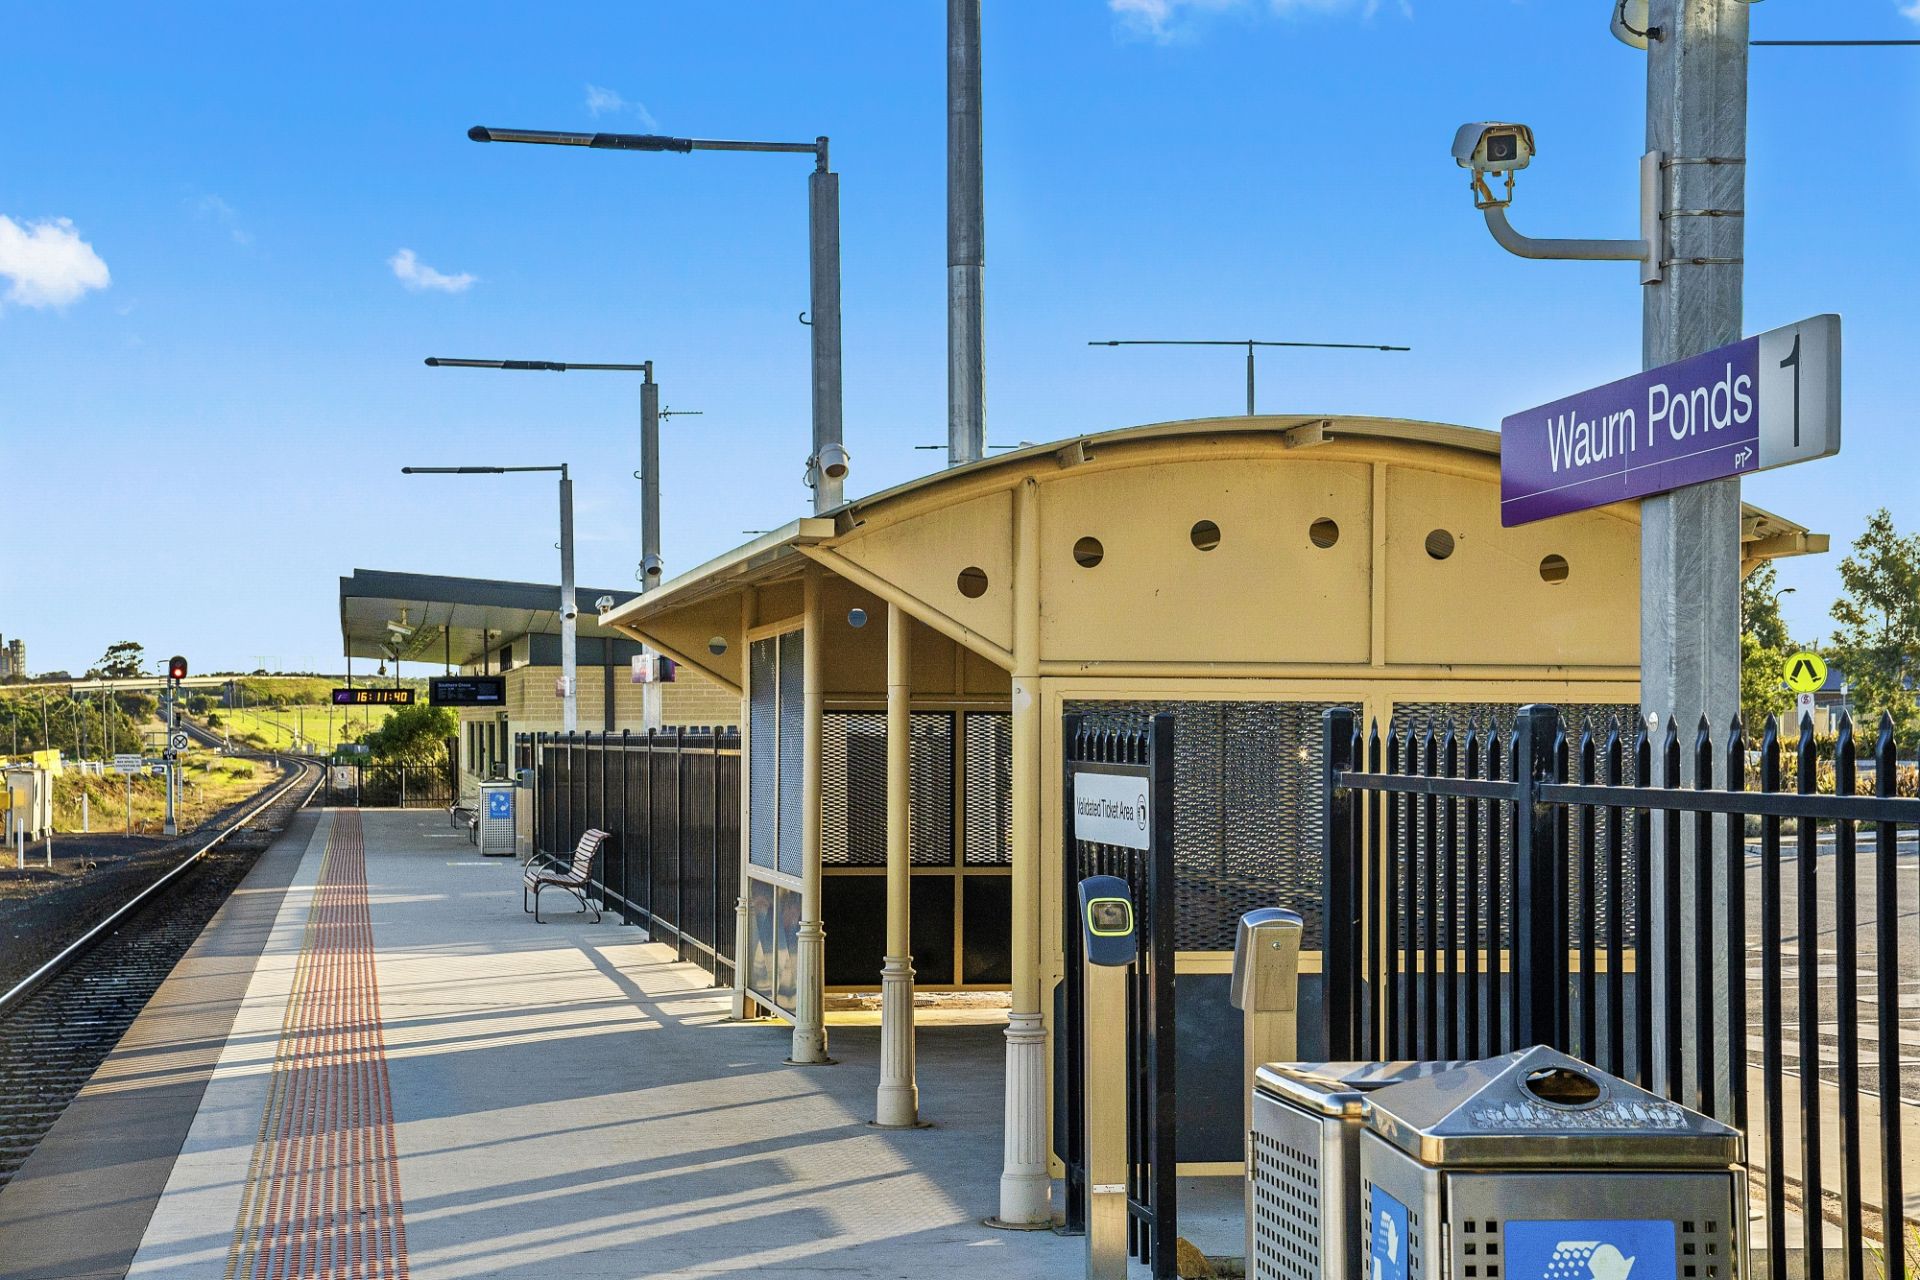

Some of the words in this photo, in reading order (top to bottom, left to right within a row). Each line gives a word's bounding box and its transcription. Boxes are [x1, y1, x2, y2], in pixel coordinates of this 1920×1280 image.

[1547, 408, 1636, 473] Waurn
[1648, 362, 1753, 447] Ponds
[1780, 333, 1801, 447] 1
[356, 691, 408, 703] 16:11:40
[1077, 797, 1101, 817] Validated
[1101, 799, 1119, 819] Ticket
[1119, 801, 1134, 821] Area
